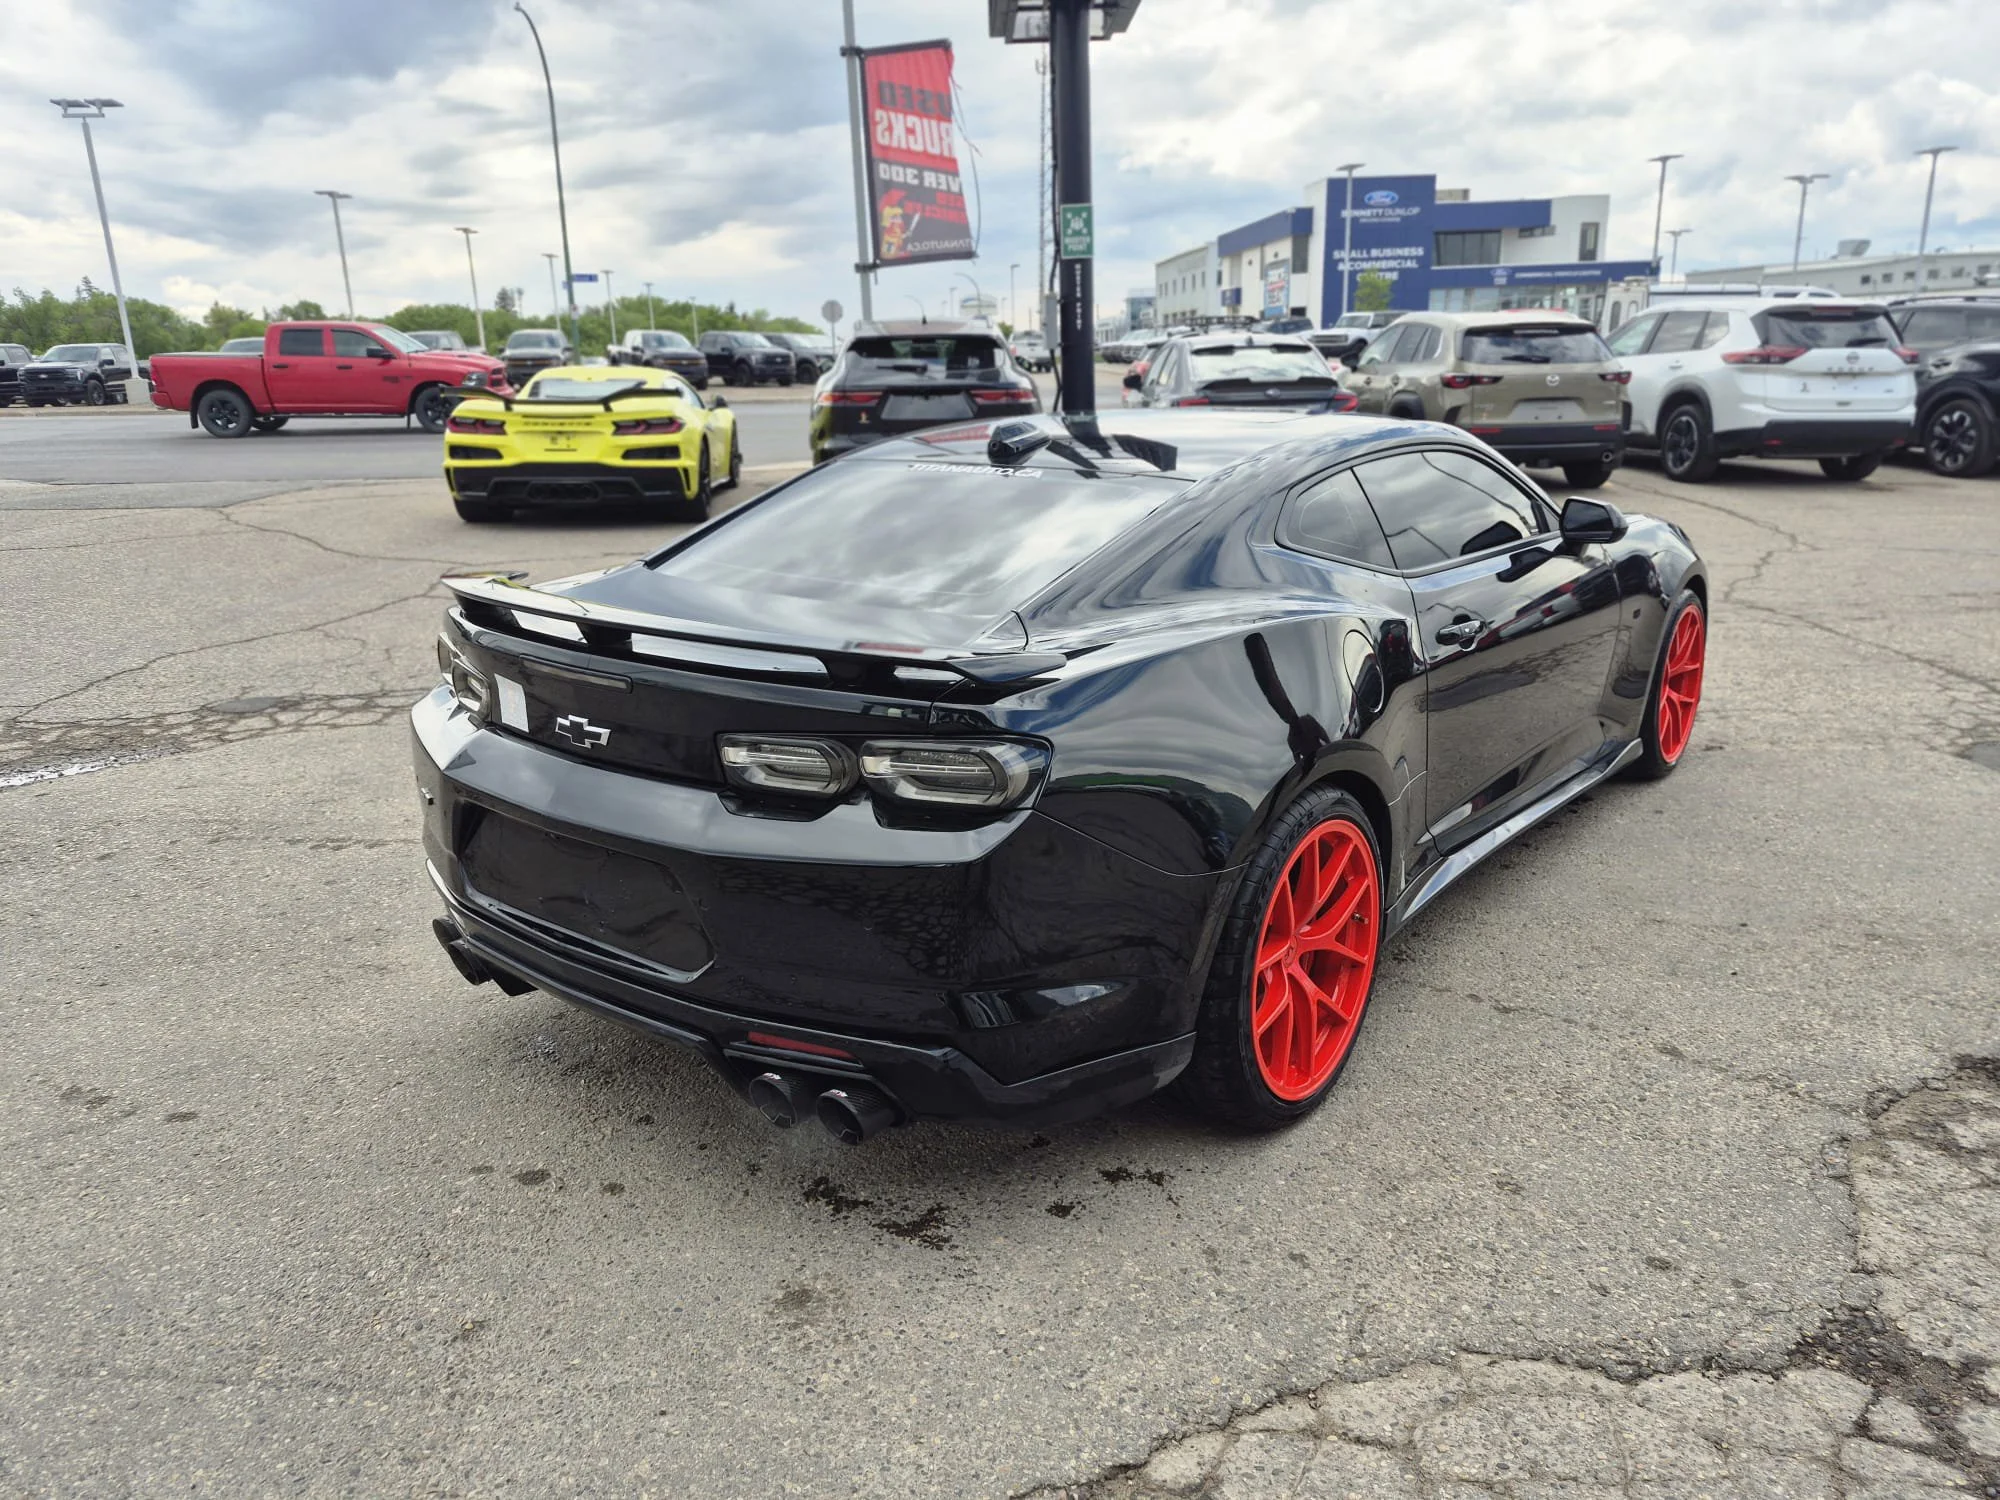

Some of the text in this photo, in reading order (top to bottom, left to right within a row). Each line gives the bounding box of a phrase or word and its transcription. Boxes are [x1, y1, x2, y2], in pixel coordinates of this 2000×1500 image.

[1341, 208, 1383, 218] BNNETT
[1370, 246, 1424, 257] BUSINESS
[1349, 258, 1419, 271] COMMERCIAL
[1356, 270, 1399, 282] CTRE
[909, 463, 1042, 478] TITANAUTO.CA
